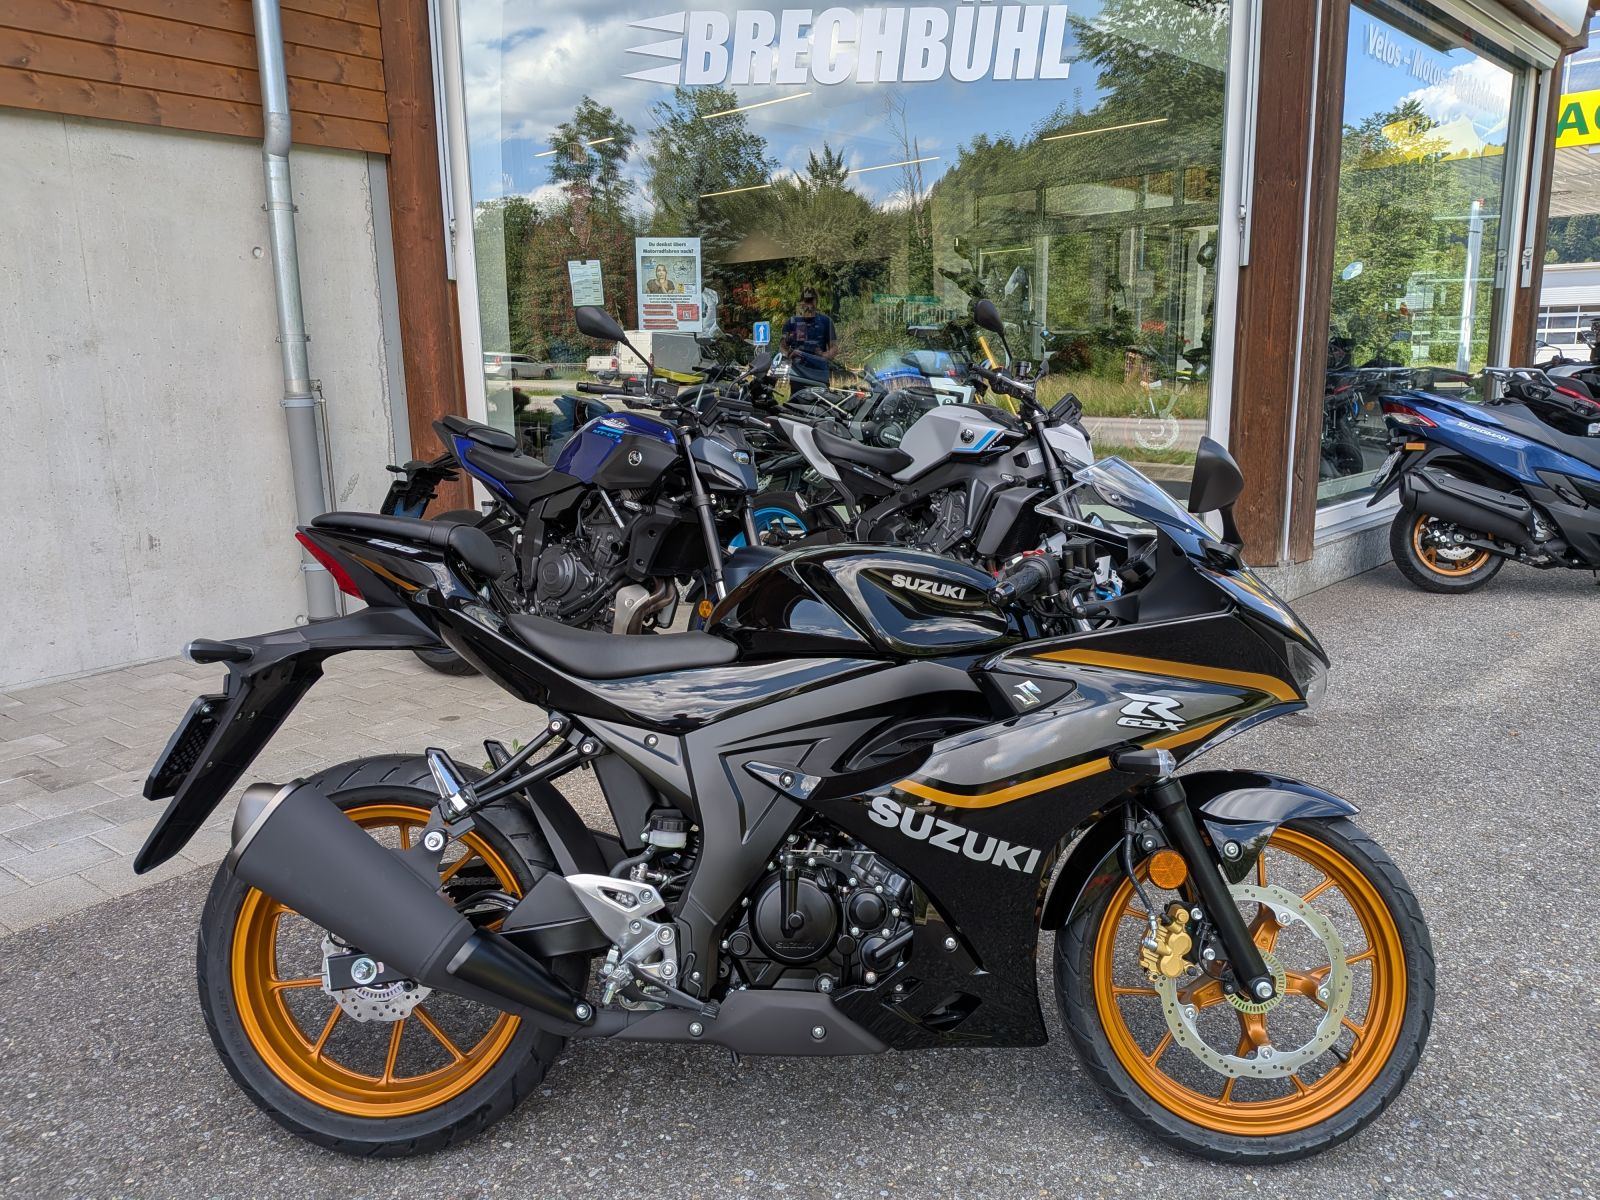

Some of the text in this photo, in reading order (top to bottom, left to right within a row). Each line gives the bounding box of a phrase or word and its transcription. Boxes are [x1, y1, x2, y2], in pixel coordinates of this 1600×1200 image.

[685, 0, 1070, 85] BRECHBÜHL
[1369, 23, 1401, 68] Velos
[891, 573, 967, 600] SUZUKI
[1116, 716, 1187, 732] GSX
[868, 796, 1042, 874] SUZUKI
